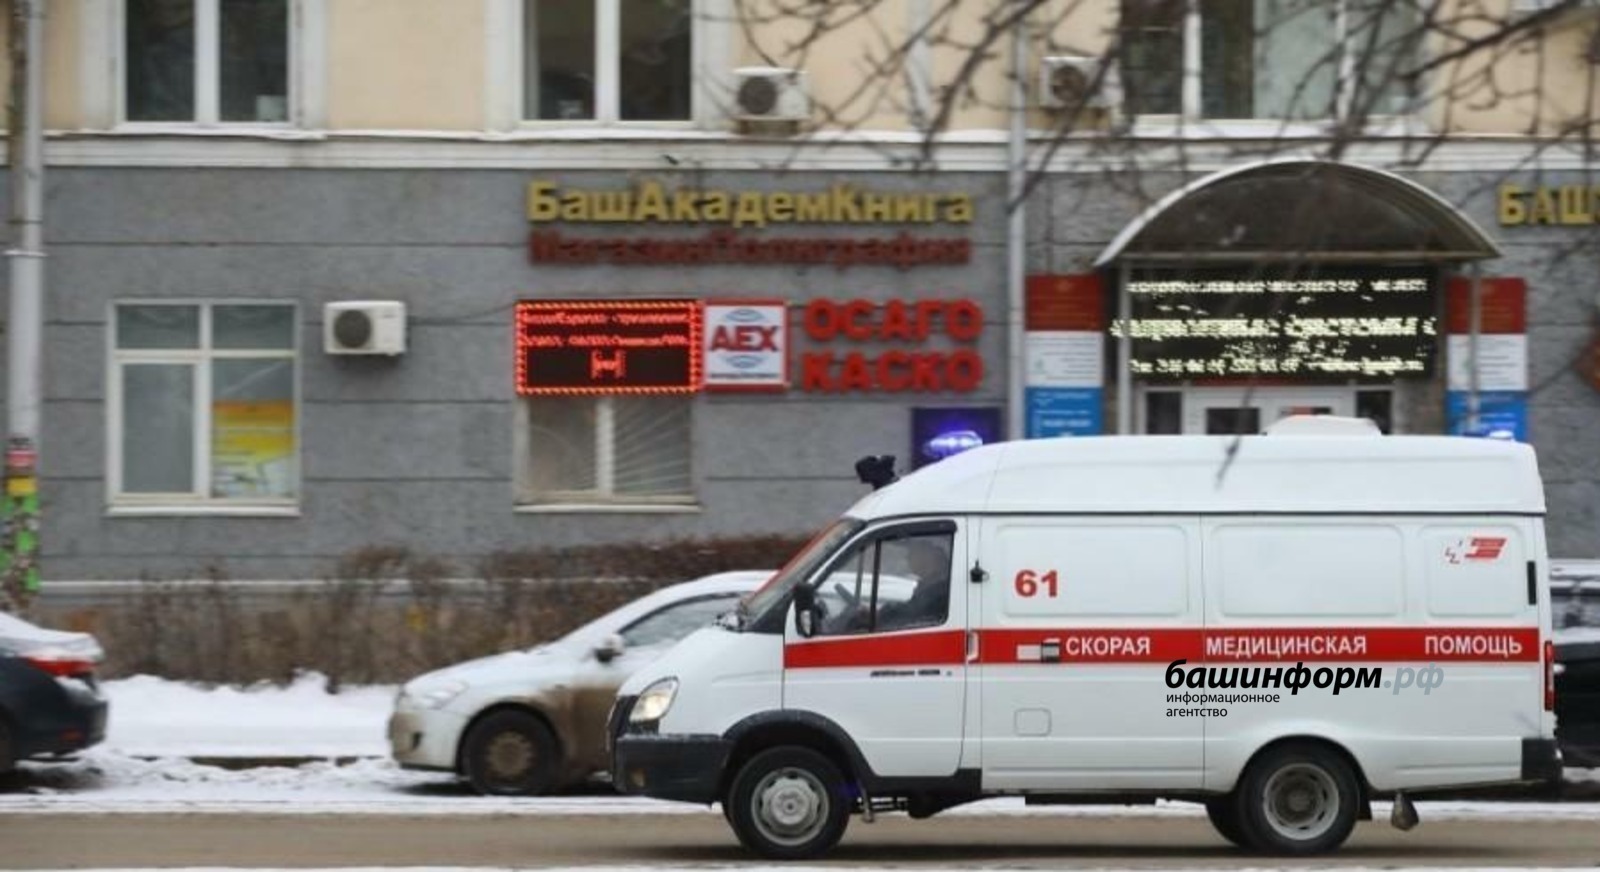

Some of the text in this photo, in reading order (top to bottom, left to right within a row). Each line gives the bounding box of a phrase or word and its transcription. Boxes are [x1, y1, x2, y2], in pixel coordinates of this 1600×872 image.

[527, 181, 974, 228] БашАкадемКнига
[1498, 184, 1600, 226] БАШ
[804, 299, 983, 341] ОСАГО
[802, 349, 983, 393] КАСКО
[1014, 570, 1060, 598] 61
[1065, 636, 1523, 658] СКОРАЯ МЕДИЦИНСКАЯ ПОМОЩЬ
